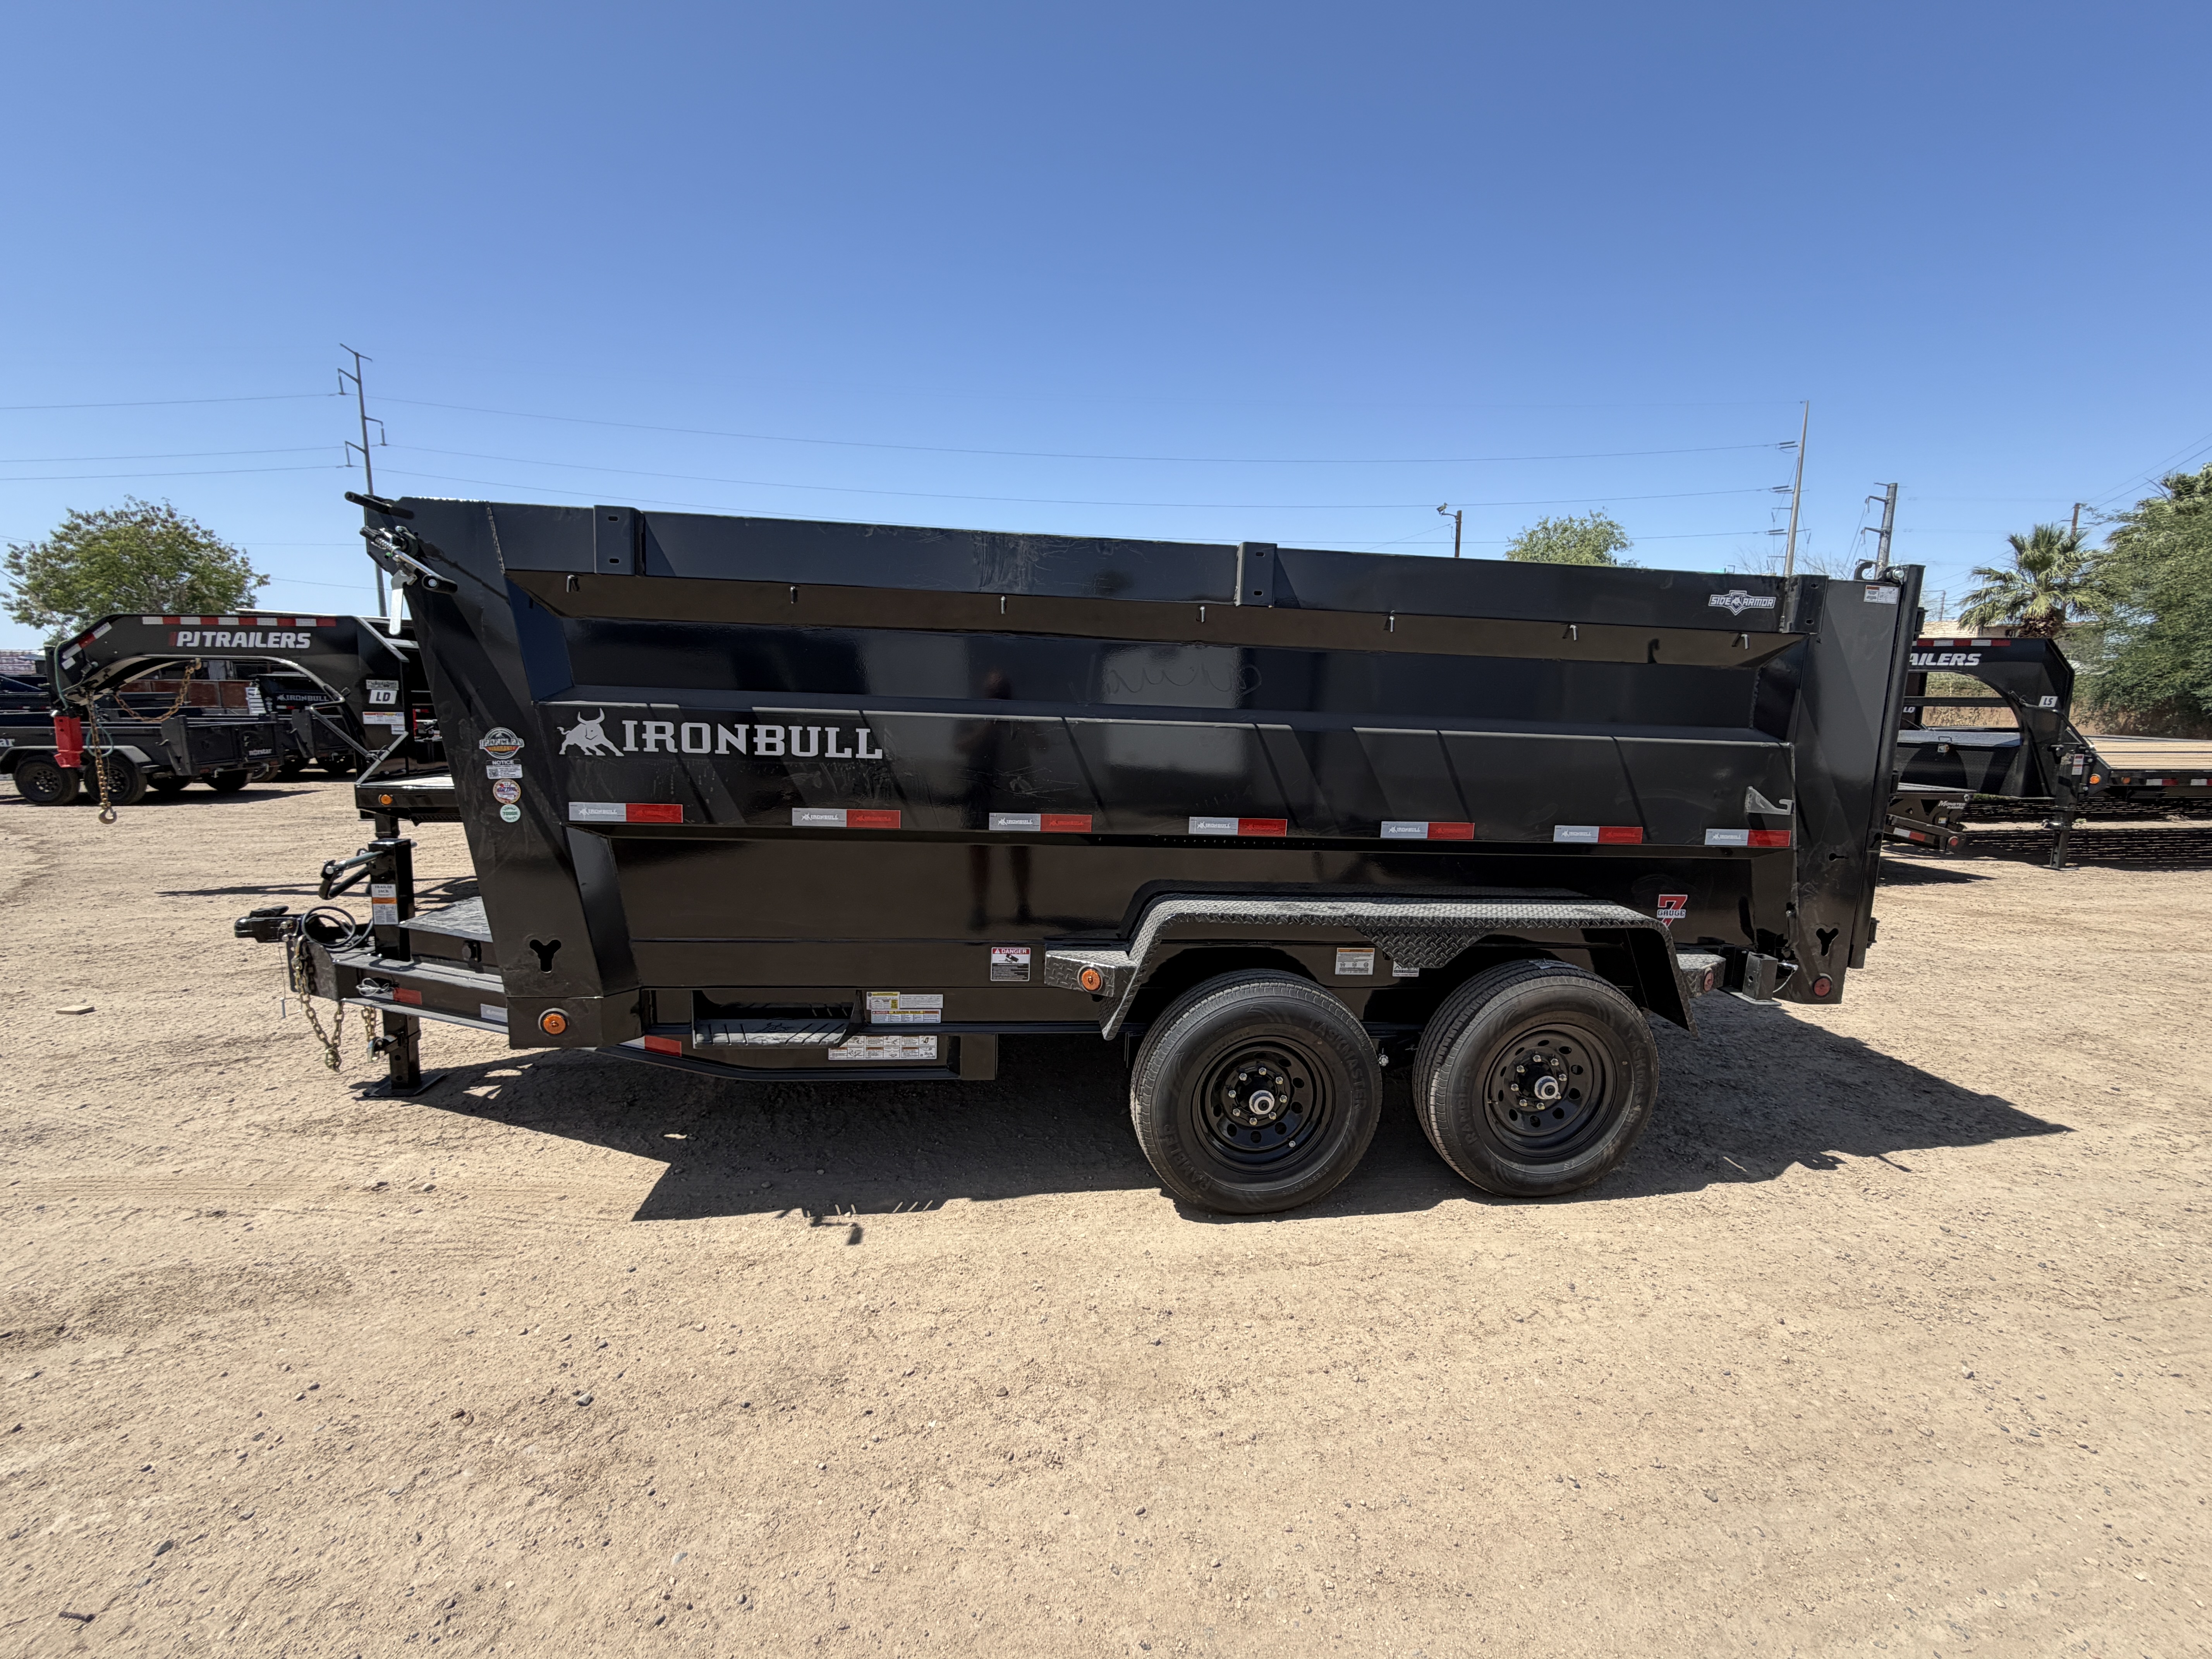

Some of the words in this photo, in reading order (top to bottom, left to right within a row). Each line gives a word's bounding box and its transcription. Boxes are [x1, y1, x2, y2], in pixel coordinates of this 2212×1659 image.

[1711, 597, 1732, 605] SIDE
[1743, 598, 1774, 607] ARMOR
[177, 631, 200, 647] PJ
[203, 632, 311, 649] TRAILERS
[376, 692, 391, 702] LD
[622, 720, 883, 759] IRONBULL
[1309, 1016, 1367, 1109] TASKMASTER
